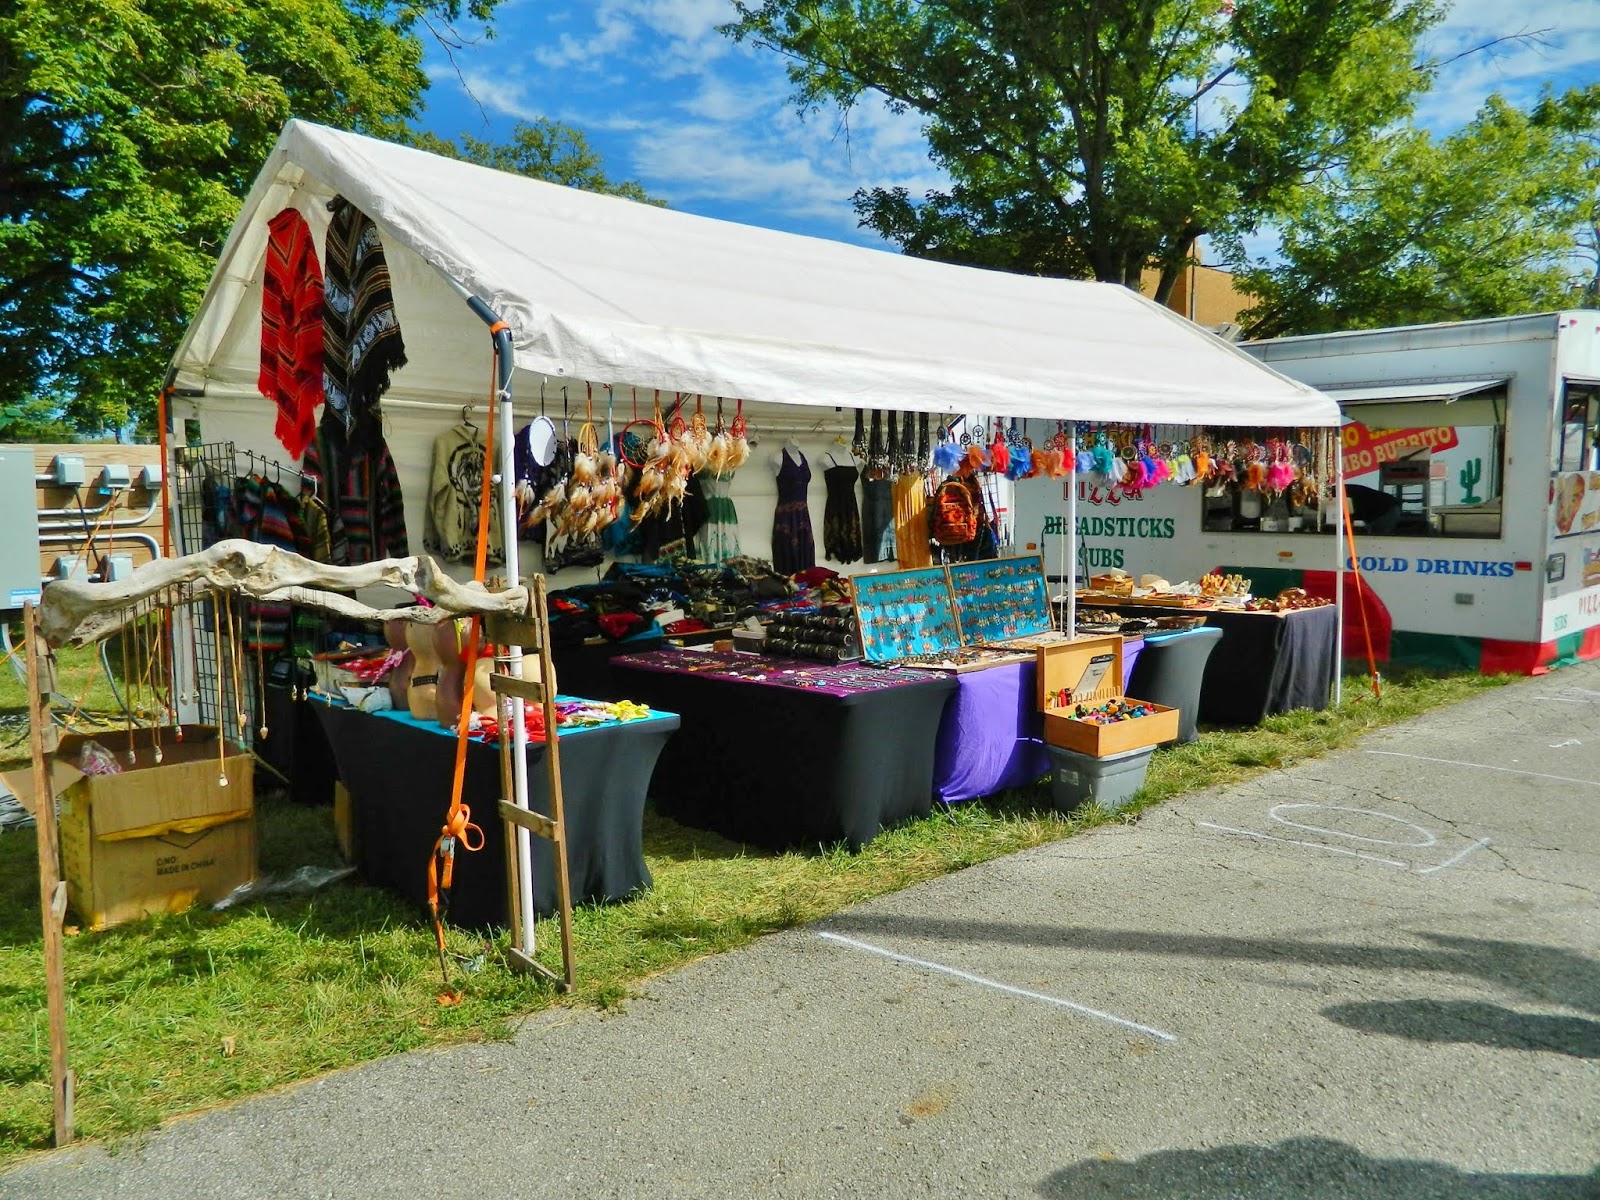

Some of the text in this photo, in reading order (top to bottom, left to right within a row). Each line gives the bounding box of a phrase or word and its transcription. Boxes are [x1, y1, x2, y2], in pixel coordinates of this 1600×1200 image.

[1044, 516, 1175, 539] BRADSTICKS
[1078, 547, 1124, 569] SUBS
[1346, 556, 1514, 578] COLD DRINKS
[157, 859, 215, 876] MADE IN CHINA
